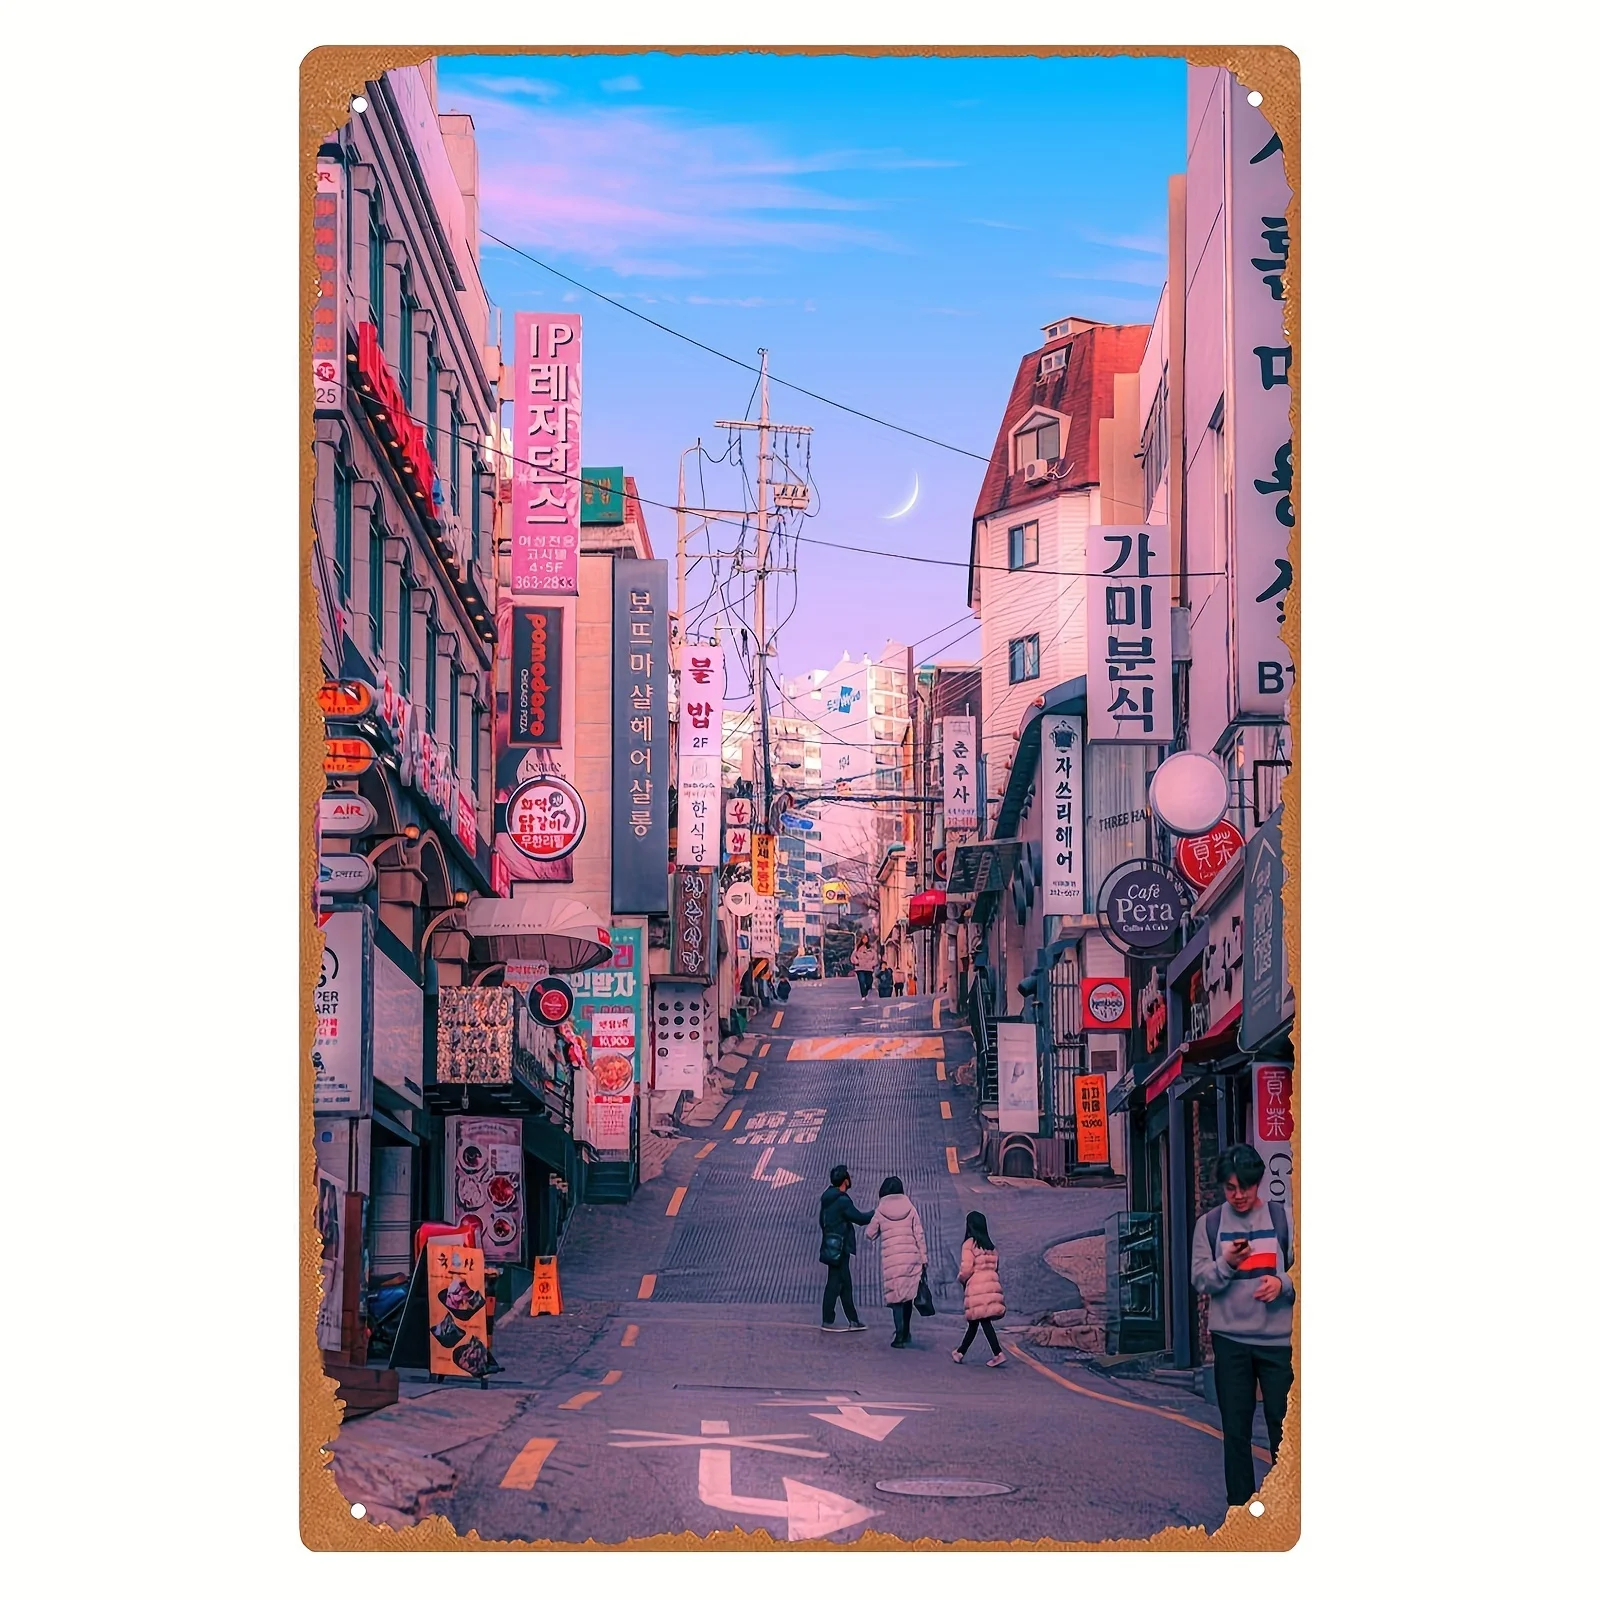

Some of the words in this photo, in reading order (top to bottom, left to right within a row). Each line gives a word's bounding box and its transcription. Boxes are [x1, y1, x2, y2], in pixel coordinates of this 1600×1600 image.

[530, 323, 574, 359] IP
[1102, 532, 1157, 733] 가미분식
[524, 613, 552, 737] pomodoro
[692, 737, 709, 749] 2F
[690, 800, 708, 863] 한식당
[1098, 812, 1130, 833] THREE
[1115, 898, 1175, 923] Pera
[1262, 1069, 1286, 1138] 貢茶
